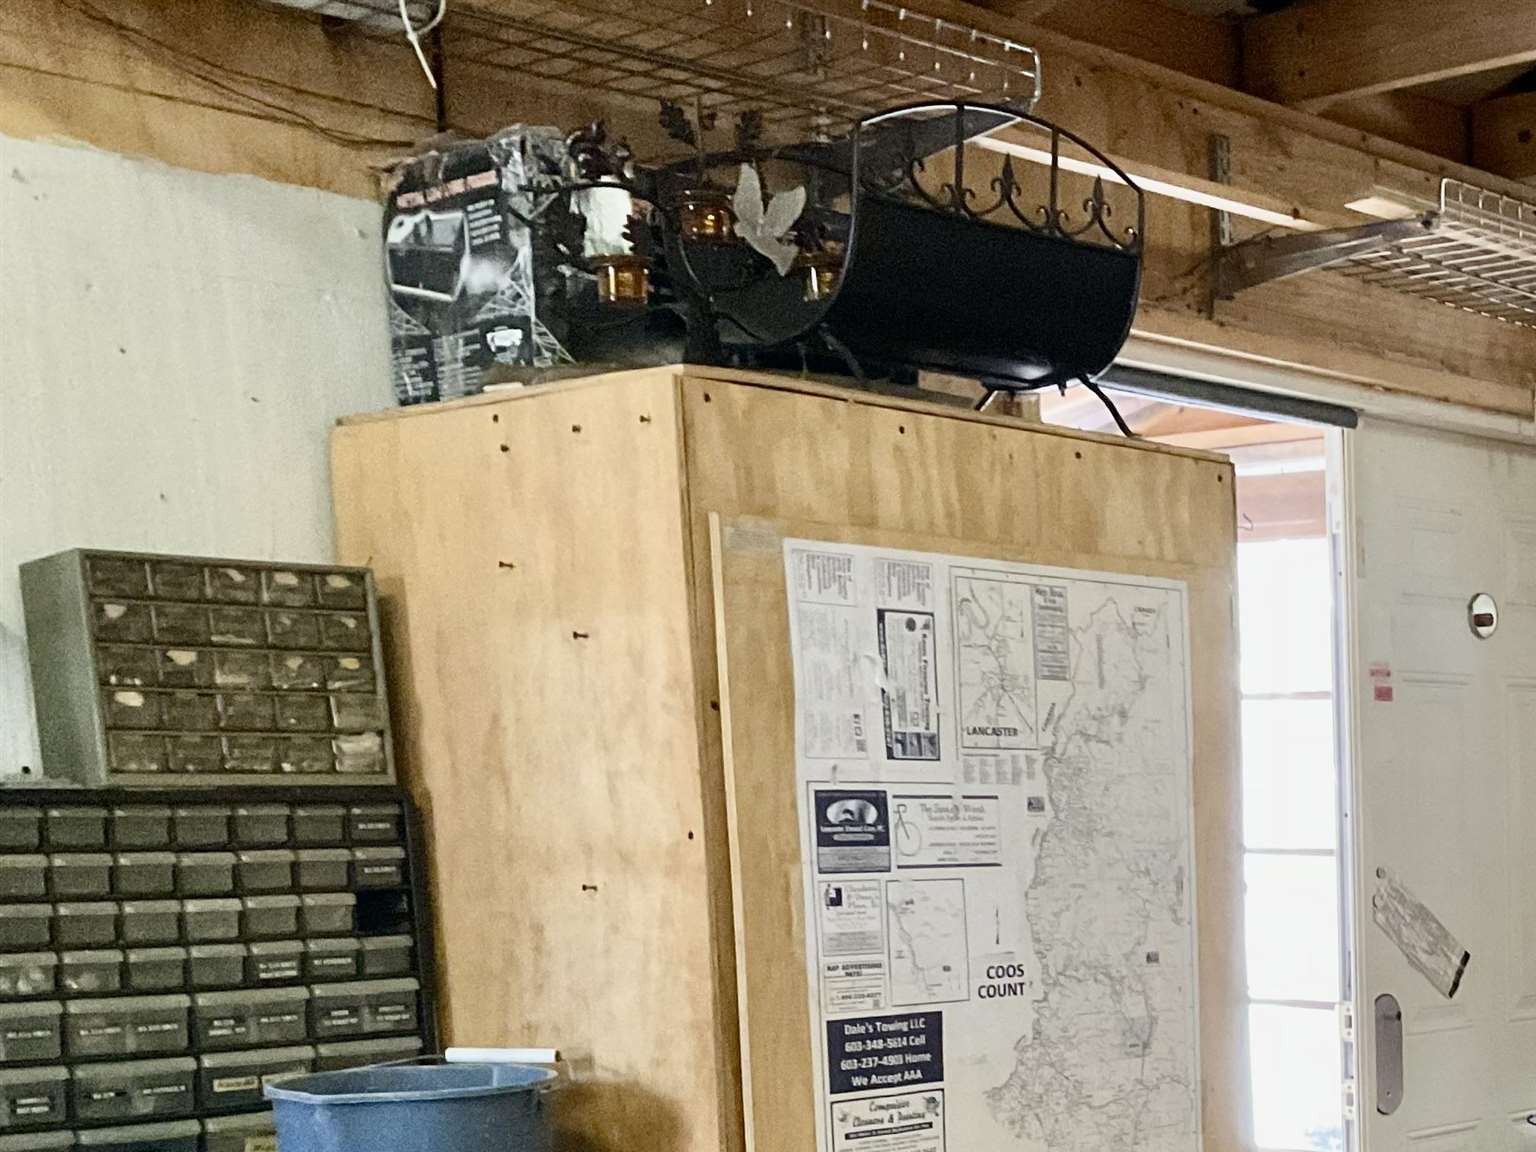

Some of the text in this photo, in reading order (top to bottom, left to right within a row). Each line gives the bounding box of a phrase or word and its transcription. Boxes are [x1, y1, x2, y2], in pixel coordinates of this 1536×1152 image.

[966, 726, 1018, 737] LANCASTER
[986, 964, 1025, 979] COOS
[978, 980, 1033, 999] COUNT
[844, 1018, 926, 1035] Dale's Towing LLC
[908, 1034, 926, 1046] Cell
[905, 1053, 932, 1064] Home
[851, 1069, 923, 1087] We Accept AAA
